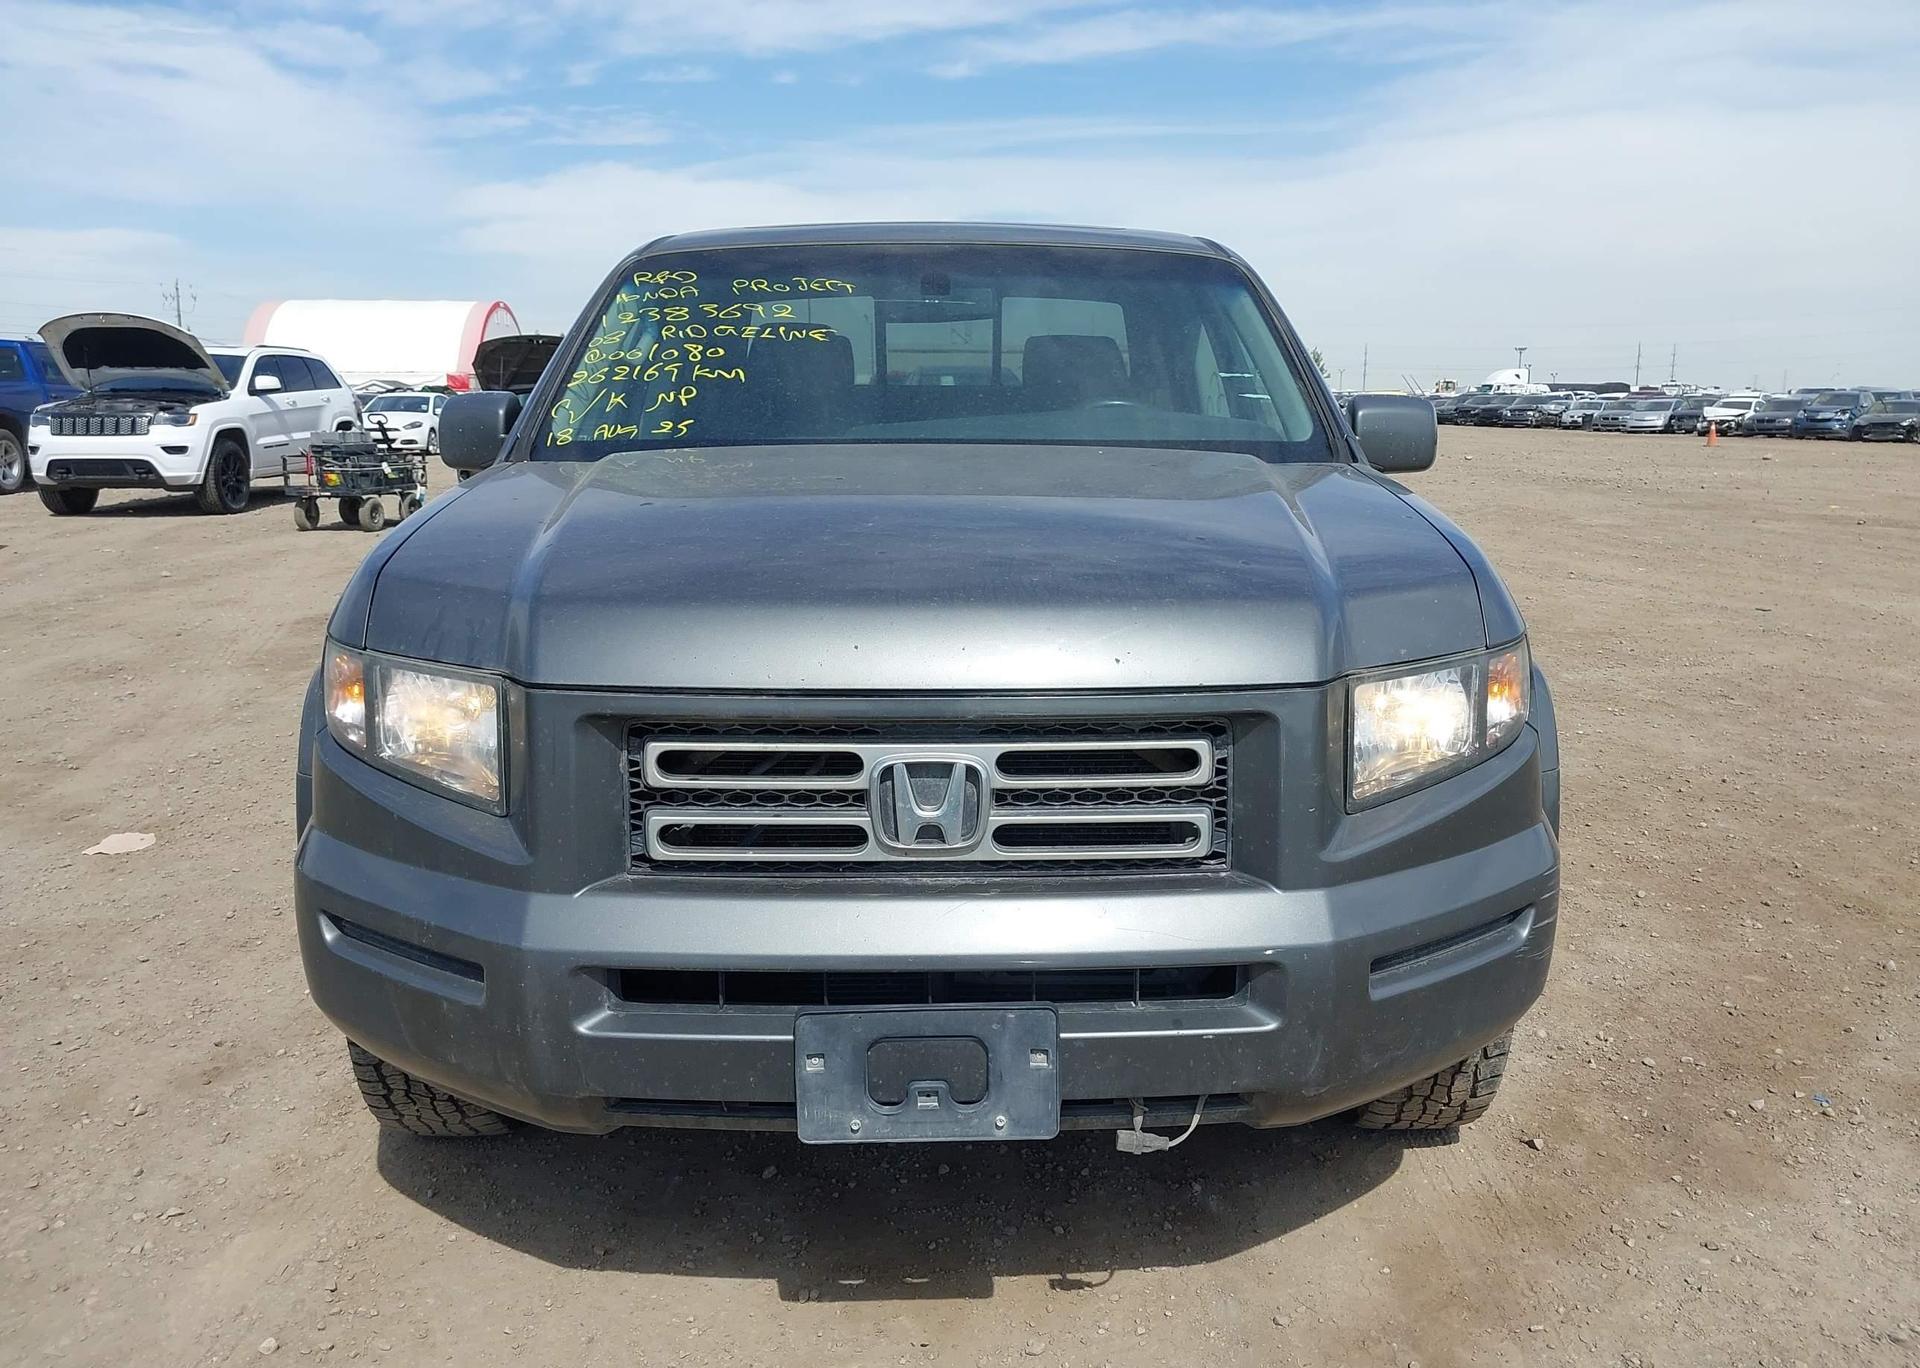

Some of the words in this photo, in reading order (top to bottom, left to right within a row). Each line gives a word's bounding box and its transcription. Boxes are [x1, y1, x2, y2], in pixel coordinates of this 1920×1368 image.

[633, 270, 697, 287] R&D
[732, 277, 856, 296] PROJECT
[546, 427, 574, 447] 18
[650, 419, 695, 438] 25
